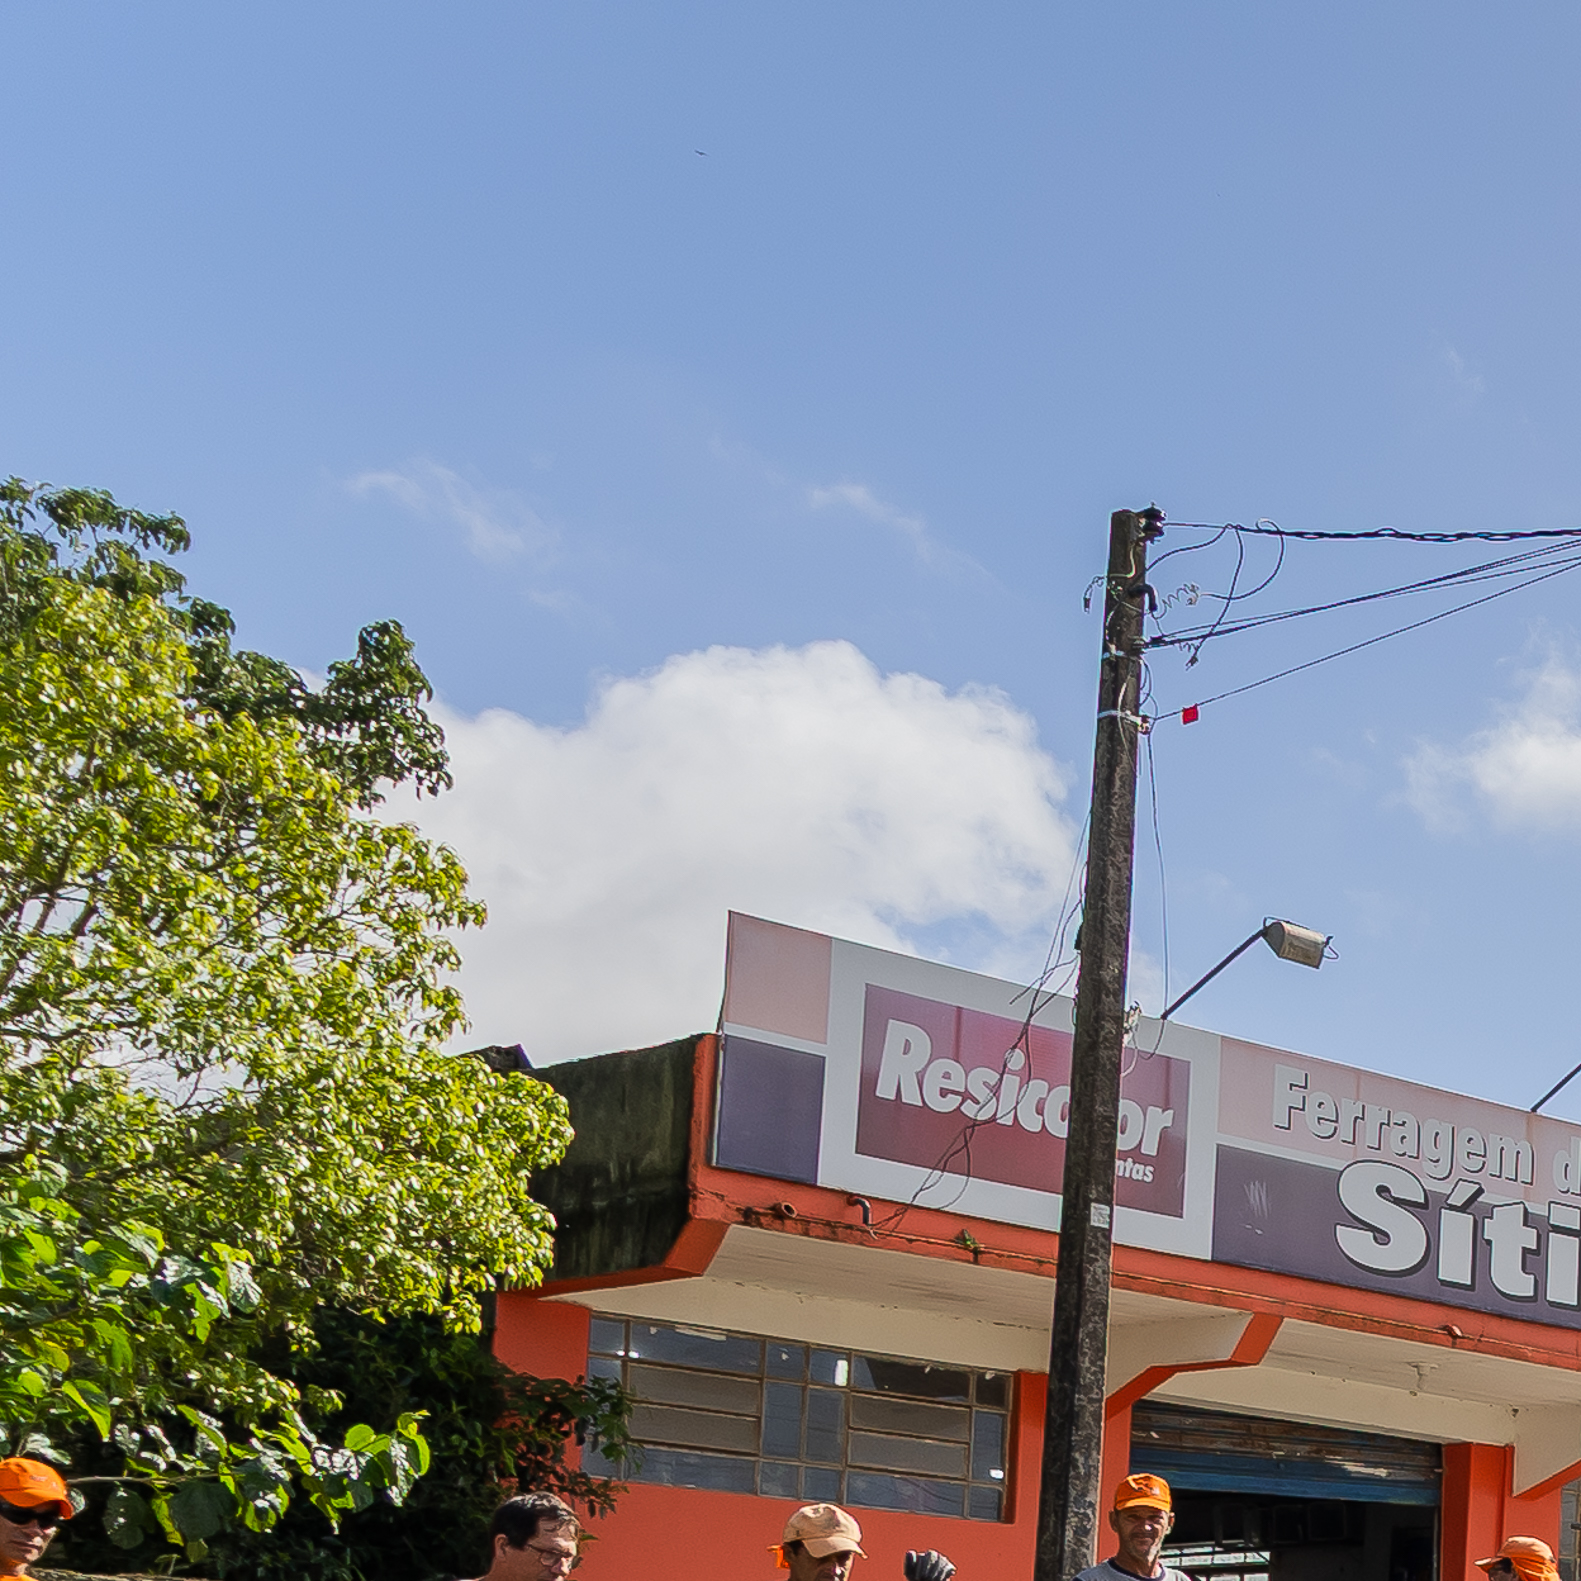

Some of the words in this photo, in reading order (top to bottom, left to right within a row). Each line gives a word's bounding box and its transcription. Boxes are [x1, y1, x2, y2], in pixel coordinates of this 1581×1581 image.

[875, 1018, 1175, 1158] Resicoor
[1272, 1063, 1535, 1185] Ferragem
[1115, 1157, 1155, 1183] ntas
